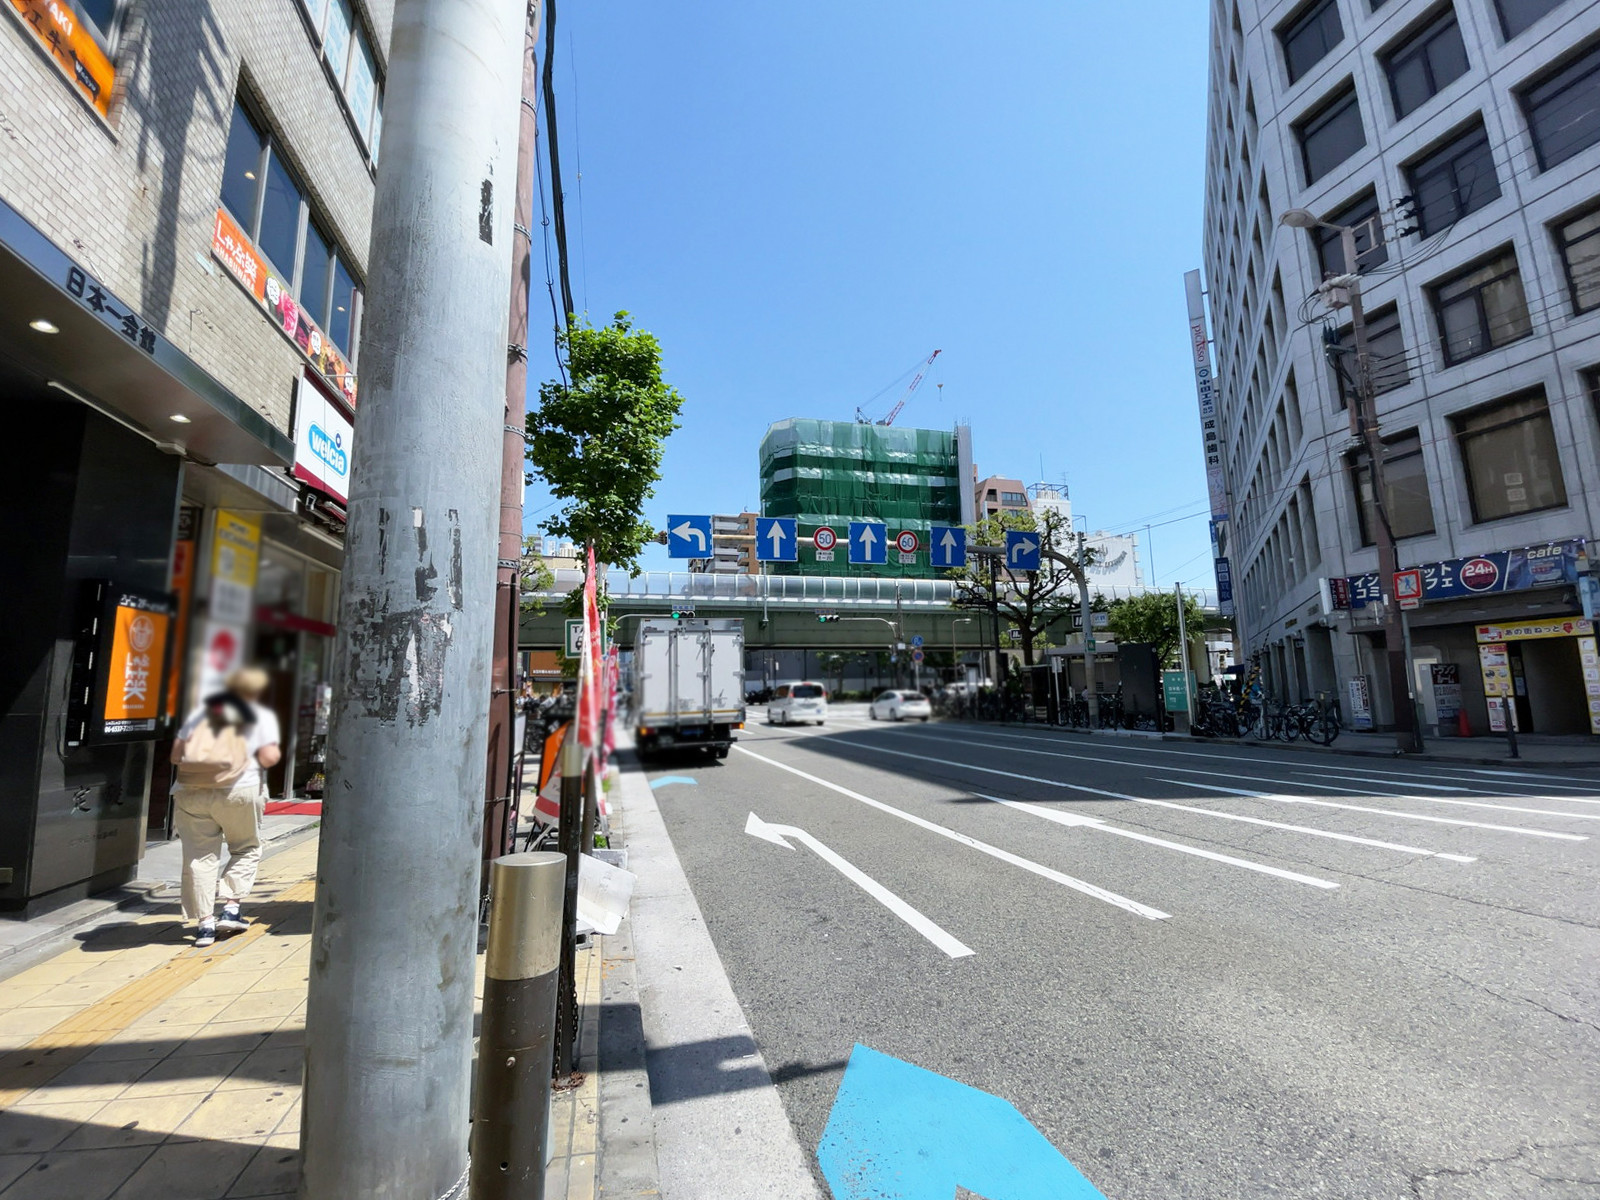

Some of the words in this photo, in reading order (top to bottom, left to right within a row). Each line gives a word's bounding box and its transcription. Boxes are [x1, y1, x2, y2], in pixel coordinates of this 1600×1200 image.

[66, 266, 157, 355] 日本一会館
[1204, 419, 1220, 466] 成島歯科
[311, 432, 345, 474] welcia
[818, 533, 832, 545] 50
[901, 537, 914, 548] 60
[1527, 546, 1562, 560] cafe
[1465, 563, 1493, 577] 24H
